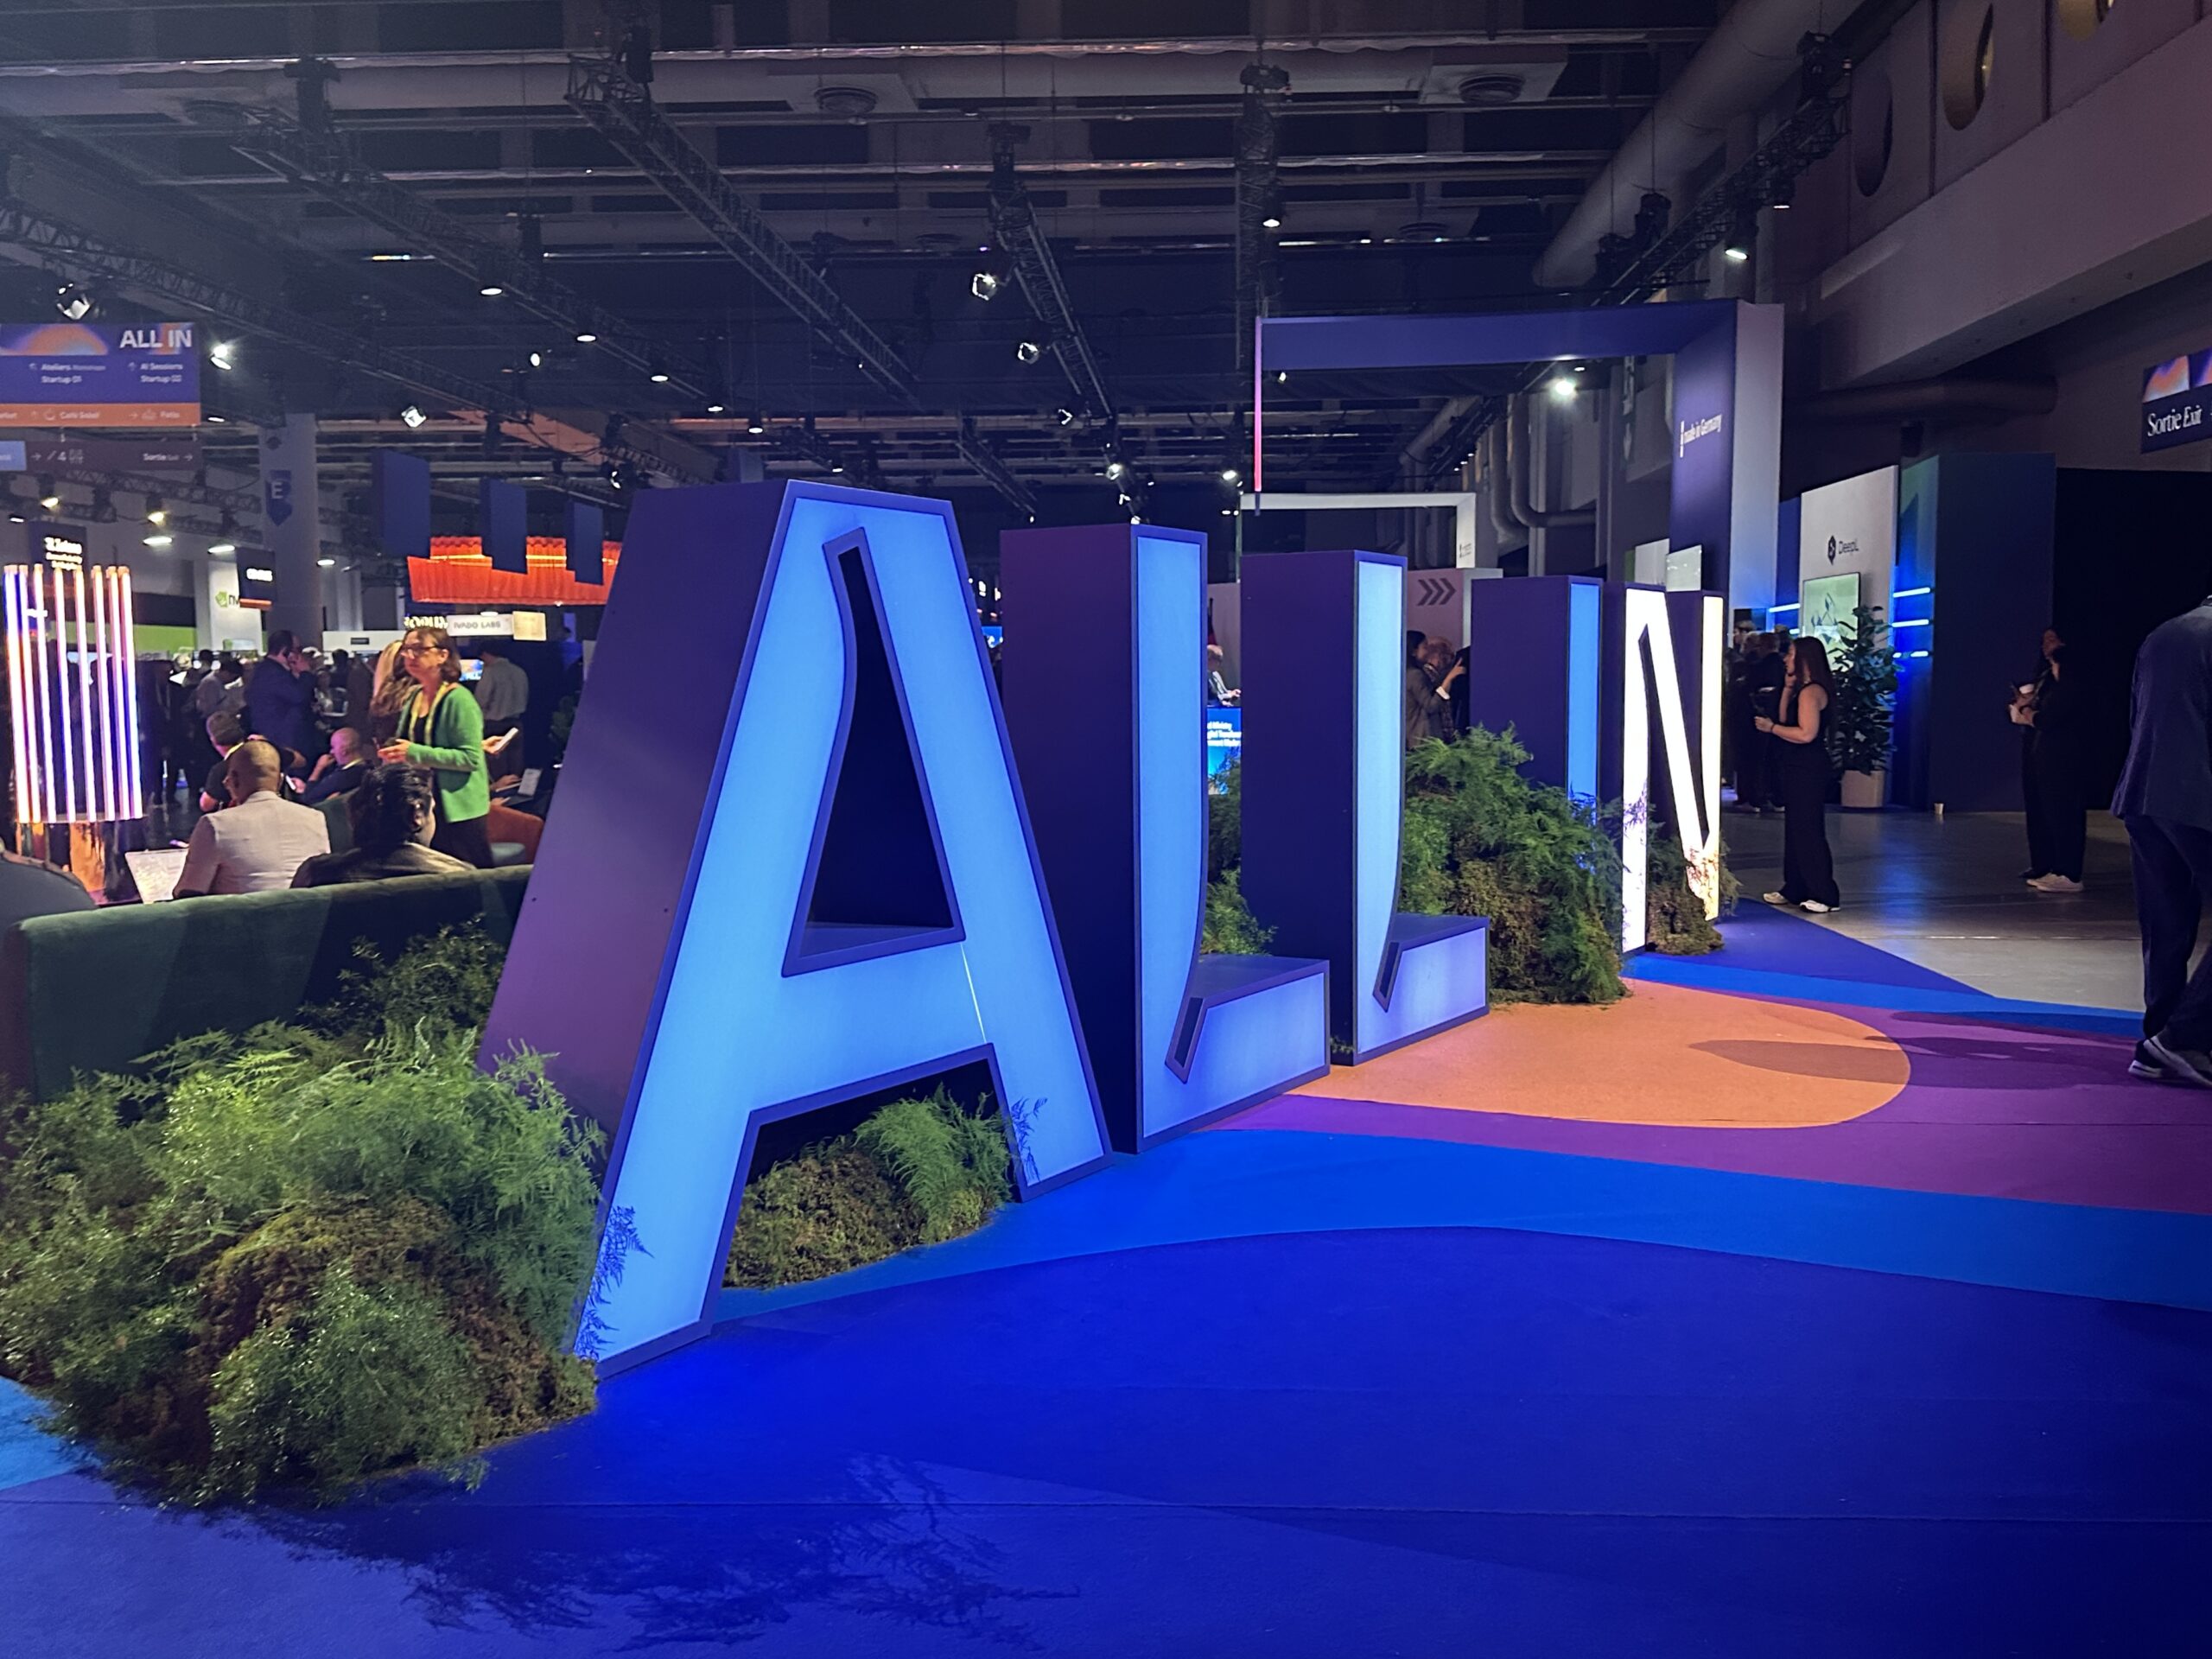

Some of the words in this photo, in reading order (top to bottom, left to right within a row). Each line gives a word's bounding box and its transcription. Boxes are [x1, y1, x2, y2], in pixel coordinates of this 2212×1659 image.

[119, 329, 163, 348] ALL
[168, 329, 192, 347] IN
[1700, 414, 1722, 436] Germany
[2147, 409, 2182, 436] Sortie
[2183, 405, 2202, 428] Exit
[271, 481, 283, 499] E
[480, 620, 501, 629] LABS
[577, 480, 1490, 1379] ALL
[1565, 575, 1726, 953] IN
